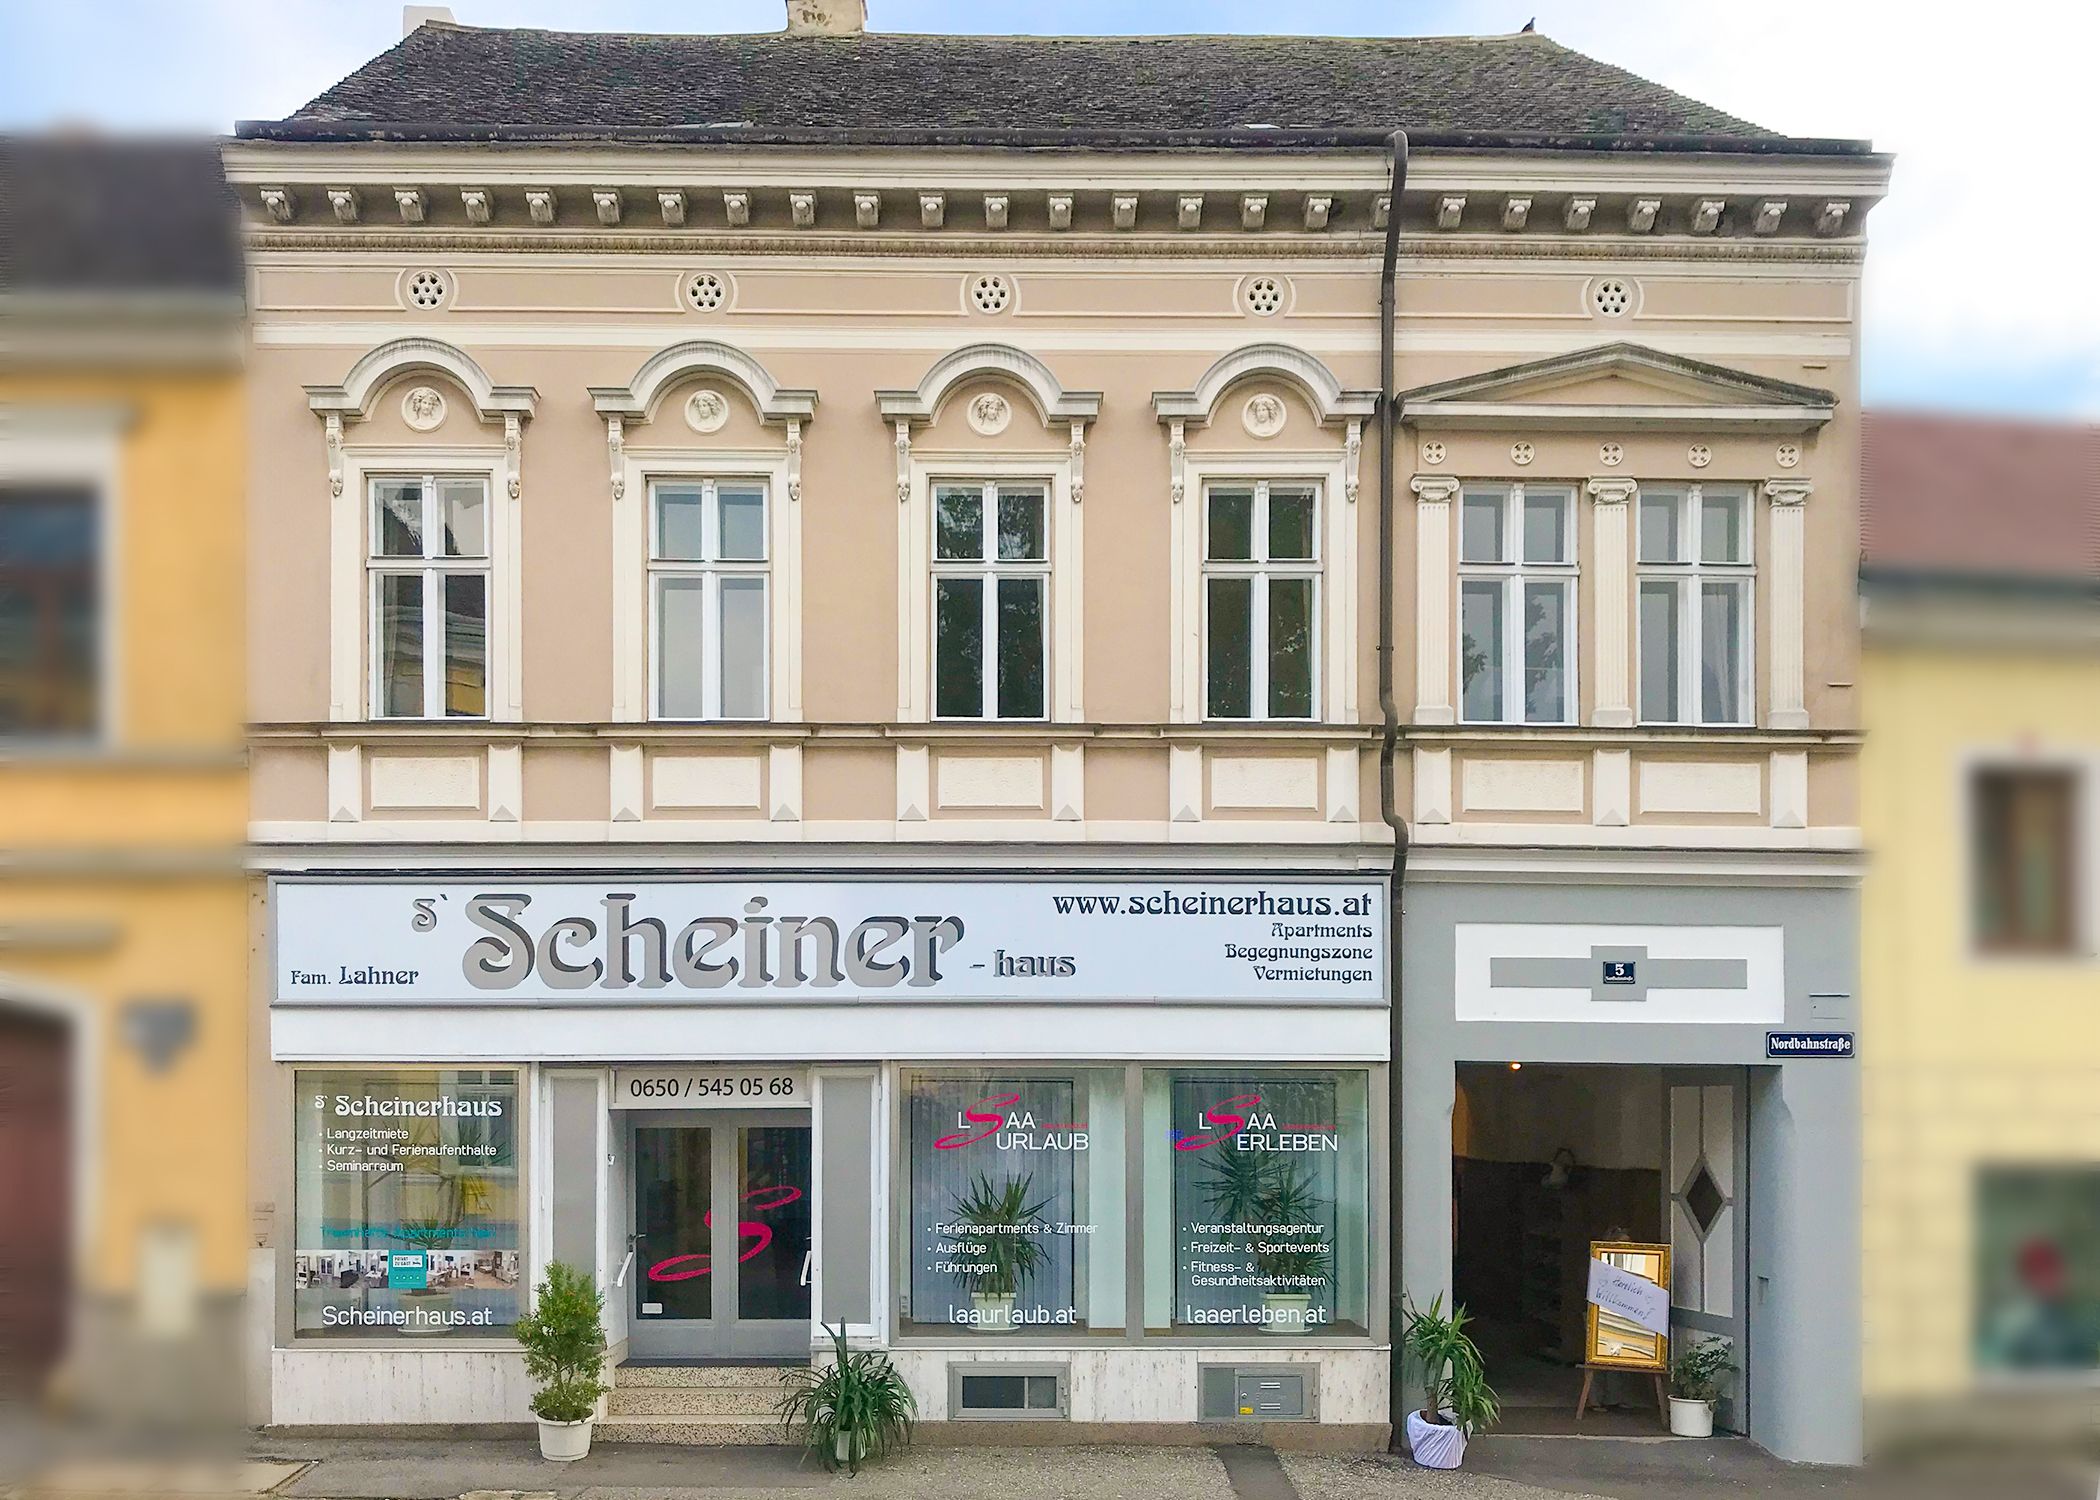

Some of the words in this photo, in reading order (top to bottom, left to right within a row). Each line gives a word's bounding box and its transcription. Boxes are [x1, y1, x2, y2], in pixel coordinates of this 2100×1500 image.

[1052, 890, 1372, 915] www.scheinerhaus.at
[1271, 922, 1374, 940] Apartments
[462, 893, 965, 989] Scheiner
[1225, 943, 1374, 962] Begegnungszone
[993, 949, 1077, 978] haus
[1615, 963, 1625, 976] 5
[290, 969, 332, 985] Fam.
[338, 965, 419, 985] Lahner
[1253, 965, 1374, 983] Vermietungen
[1770, 1037, 1851, 1052] Nordbahnstraße
[630, 1078, 680, 1097] 0650
[698, 1077, 734, 1097] 545
[740, 1077, 763, 1096] 05
[769, 1077, 794, 1095] 68
[335, 1094, 503, 1118] Scheinerhaus
[326, 1128, 409, 1142] Langzeitmiete
[996, 1133, 1089, 1150] URLAUB
[1237, 1134, 1339, 1151] ERLEBEN
[326, 1144, 363, 1156] Kurz-
[367, 1144, 390, 1156] und
[392, 1143, 498, 1156] Ferienaufenthalte
[326, 1160, 404, 1172] Seminarraum
[935, 1222, 1040, 1237] Ferienapartments
[1043, 1223, 1053, 1234] &
[1056, 1222, 1099, 1235] Zimmer
[1190, 1222, 1325, 1237] Veranstaltungsagentur
[935, 1241, 988, 1257] Ausflüge
[1190, 1242, 1241, 1254] Freizeit-
[1245, 1242, 1255, 1254] &
[1257, 1241, 1330, 1256] Sportevents
[935, 1261, 998, 1275] Führungen
[1190, 1261, 1242, 1273] Fitness-
[1245, 1261, 1255, 1273] &
[1191, 1274, 1326, 1287] Gesundheitsaktivitäten
[322, 1305, 494, 1326] Scheinerhaus.at
[949, 1304, 1077, 1324] laaurlaub.at
[1187, 1304, 1327, 1324] laaerleben.at
